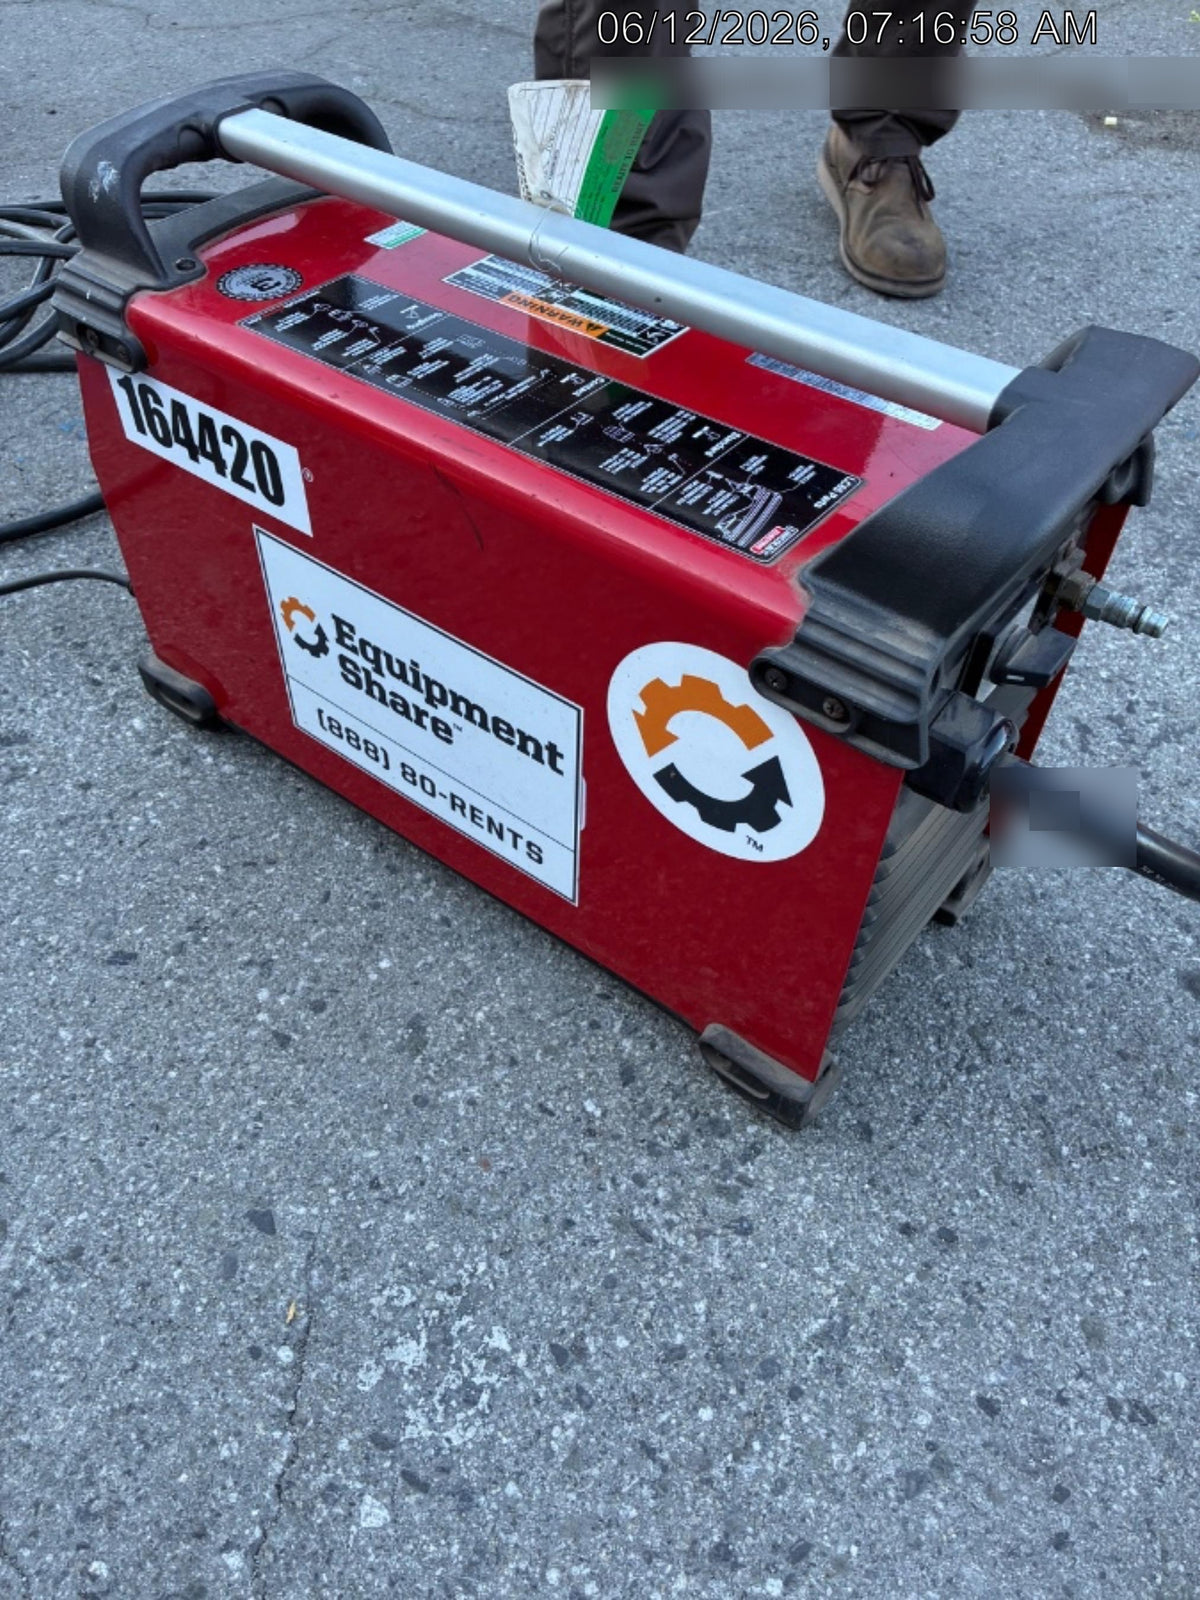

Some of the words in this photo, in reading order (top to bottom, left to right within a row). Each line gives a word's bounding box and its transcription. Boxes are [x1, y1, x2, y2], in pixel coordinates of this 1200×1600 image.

[508, 294, 584, 328] WARNING
[117, 375, 285, 507] 164420
[331, 613, 565, 777] Equipment
[337, 654, 454, 745] Share
[317, 708, 390, 771] (888)
[401, 762, 543, 866] 80-RENTS
[746, 835, 763, 852] TM
